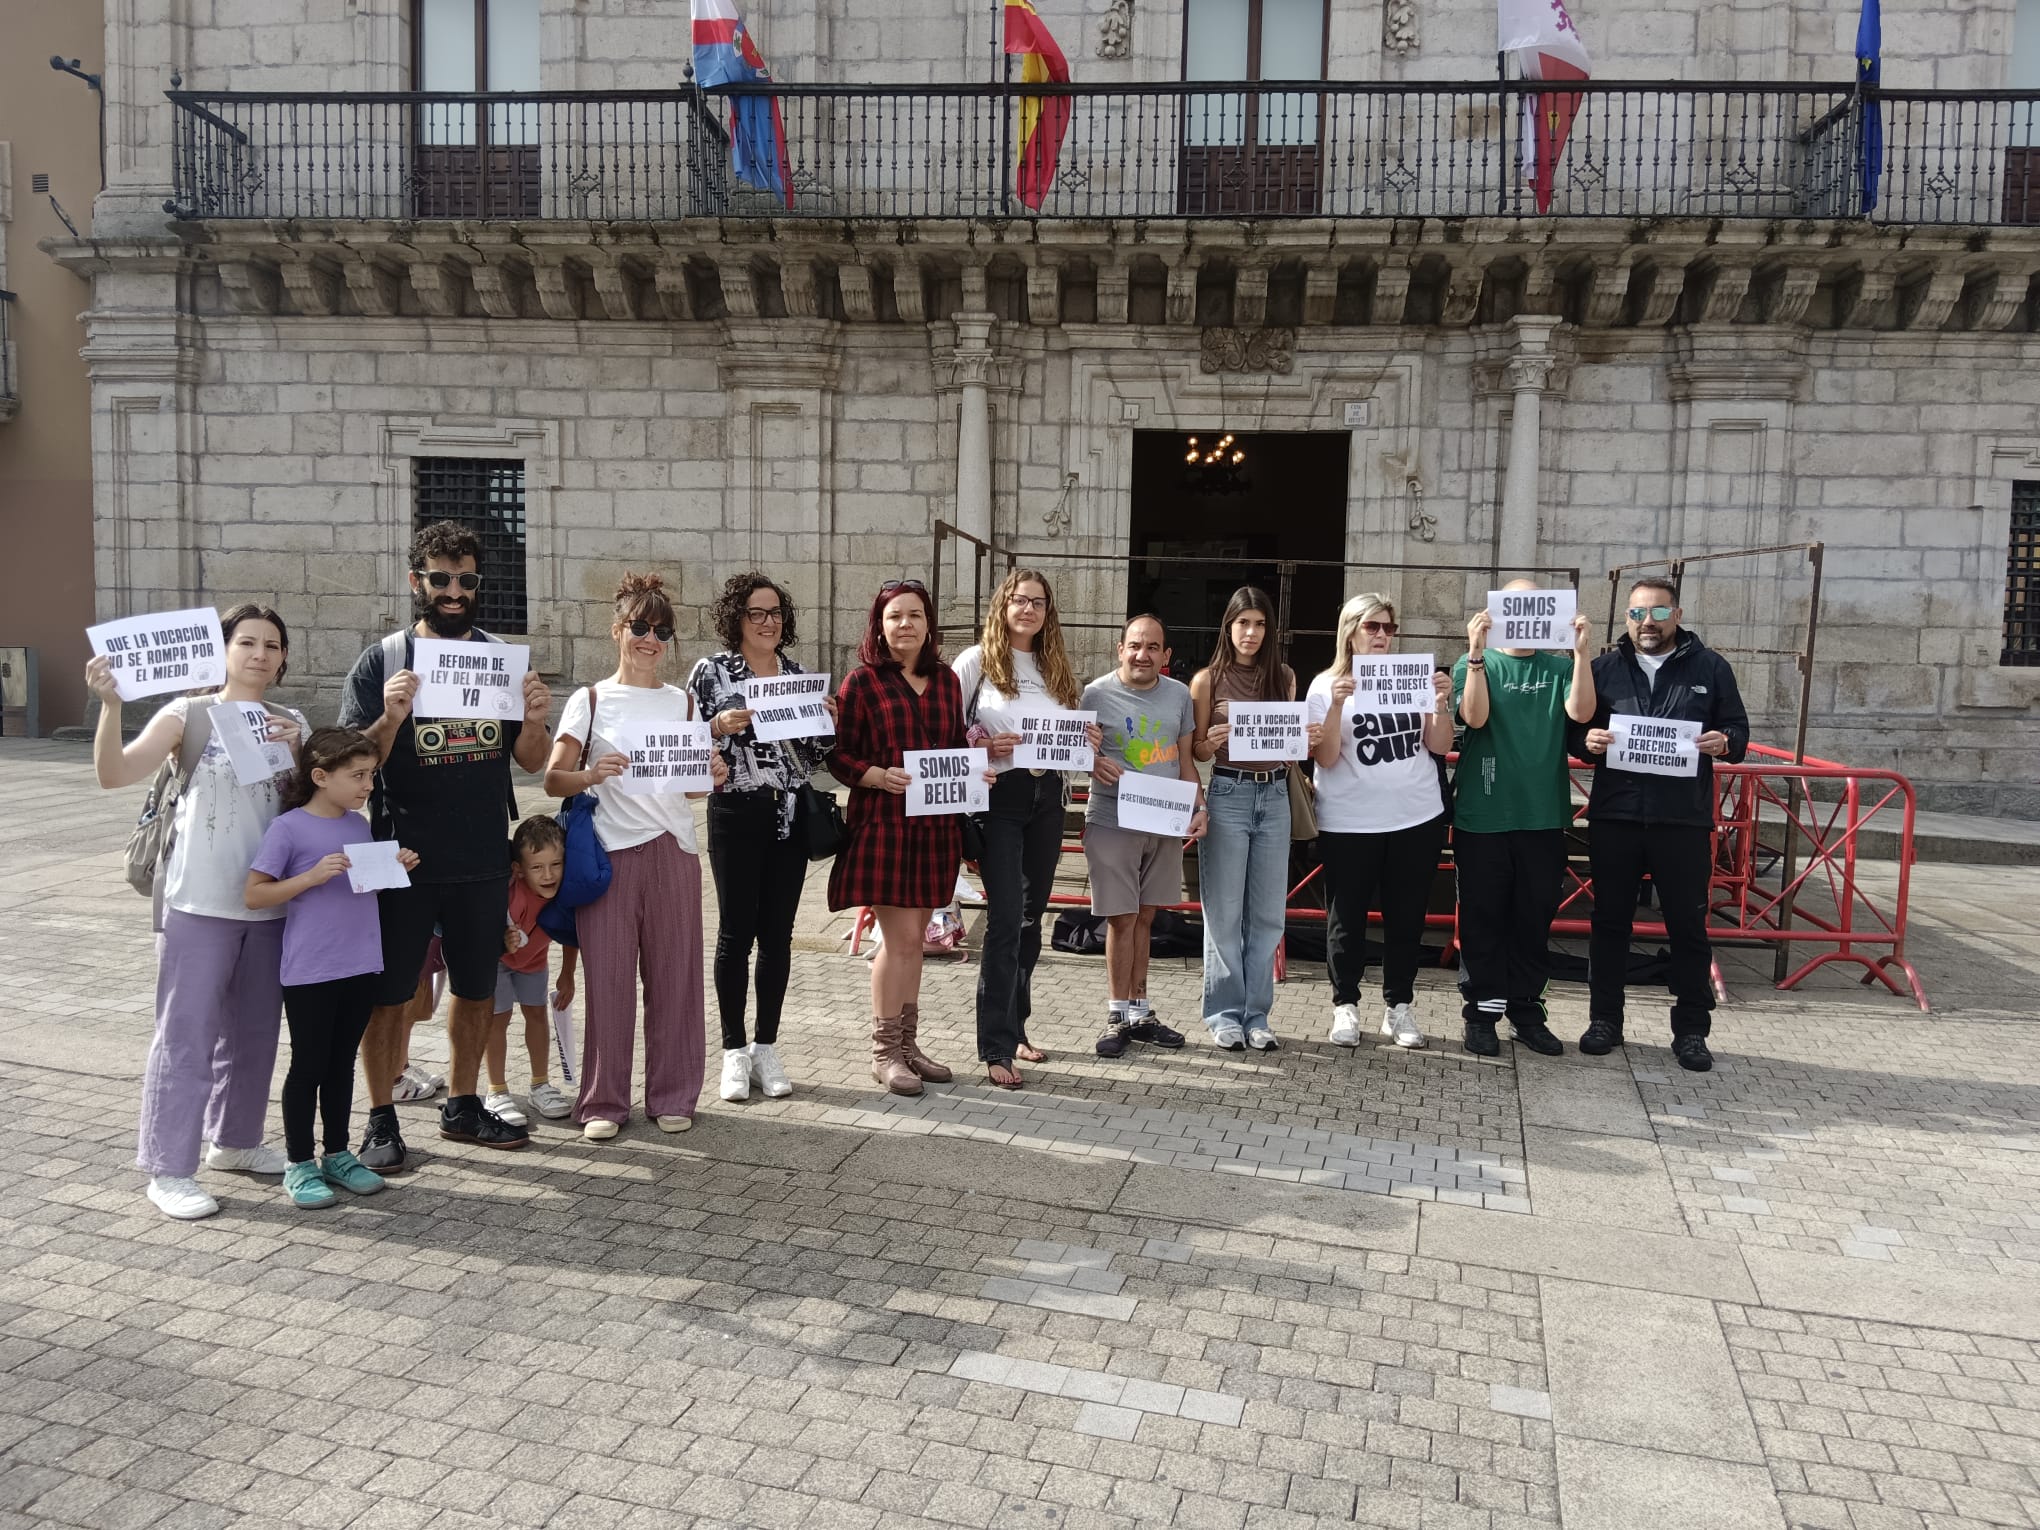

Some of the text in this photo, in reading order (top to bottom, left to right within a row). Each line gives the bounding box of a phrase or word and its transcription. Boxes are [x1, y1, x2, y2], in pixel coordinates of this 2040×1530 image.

[1502, 596, 1556, 617] SOMOS
[1505, 617, 1551, 640] BELÉN
[105, 624, 209, 653] QUE LA VOCACIÓN
[108, 642, 214, 670] NO SE ROMPA POR
[439, 653, 505, 671] REFORMA DE
[135, 663, 188, 682] EL MIEDO
[430, 669, 510, 687] LEY DEL MENOR
[1360, 663, 1429, 677] QUE EL TRABAJO
[748, 679, 825, 699] LA PRECARIEDAD
[1361, 678, 1428, 691] NO NOS CUESTE
[462, 688, 480, 707] YA
[1378, 692, 1412, 705] LA VIDA
[756, 707, 798, 723] LABORAL
[1236, 714, 1250, 725] QUE
[1253, 714, 1261, 725] LA
[1021, 717, 1039, 731] QUE
[1042, 718, 1051, 731] EL
[1234, 726, 1301, 737] NO SE ROMPA POR
[1631, 723, 1677, 739] EXIGIMOS
[645, 734, 693, 748] LA VIDA DE
[1022, 732, 1088, 747] NO NOS CUESTE
[1250, 738, 1284, 750] EL MIEDO
[1627, 738, 1677, 754] DERECHOS
[630, 749, 711, 763] LAS QUE CUIDAMOS
[1036, 747, 1070, 761] LA VIDA
[1619, 750, 1688, 768] Y PROTECCIÓN
[671, 763, 708, 777] IMPORTA
[919, 755, 970, 779] SOMOS
[924, 778, 967, 805] BELÉN
[1119, 792, 1191, 814] #SECTORSOCIALENLUCHA
